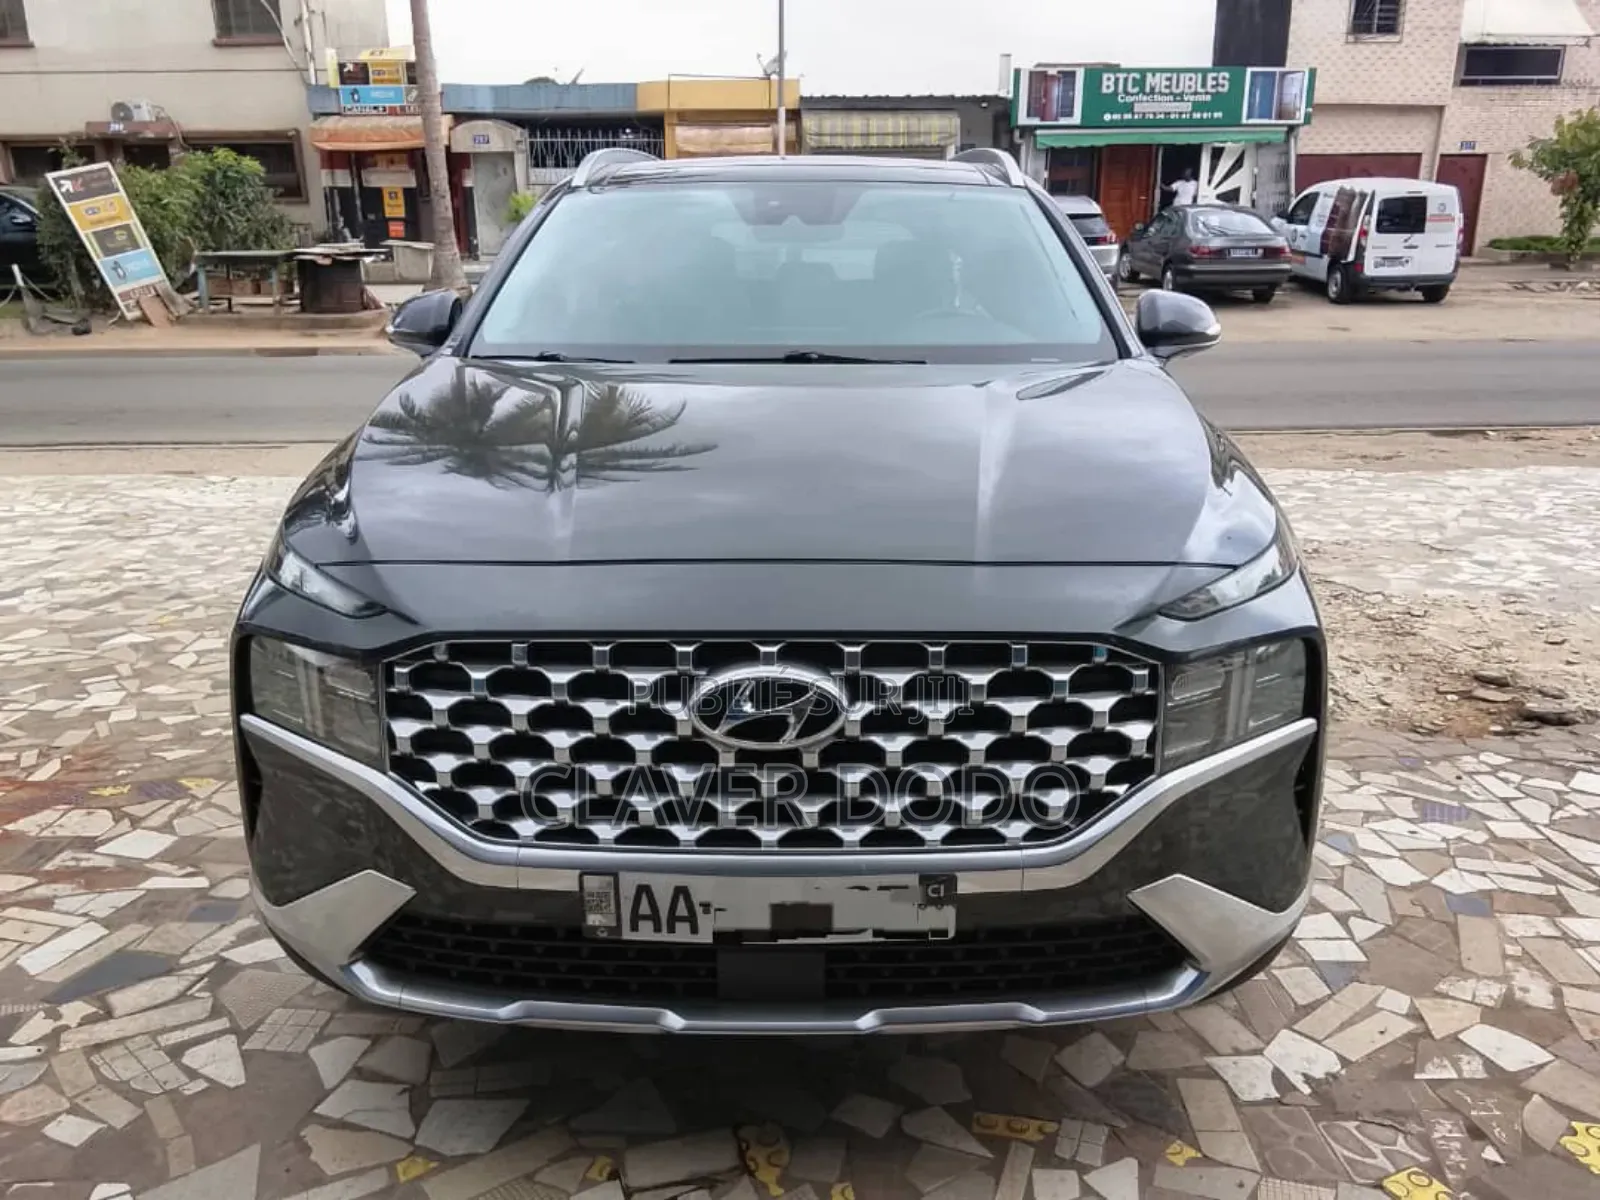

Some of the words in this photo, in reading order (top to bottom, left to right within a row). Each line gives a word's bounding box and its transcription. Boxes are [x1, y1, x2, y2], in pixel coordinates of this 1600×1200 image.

[1101, 72, 1140, 94] BTC
[1145, 72, 1230, 93] MEUBLES
[1118, 93, 1174, 103] Confection
[1184, 93, 1212, 102] Vente
